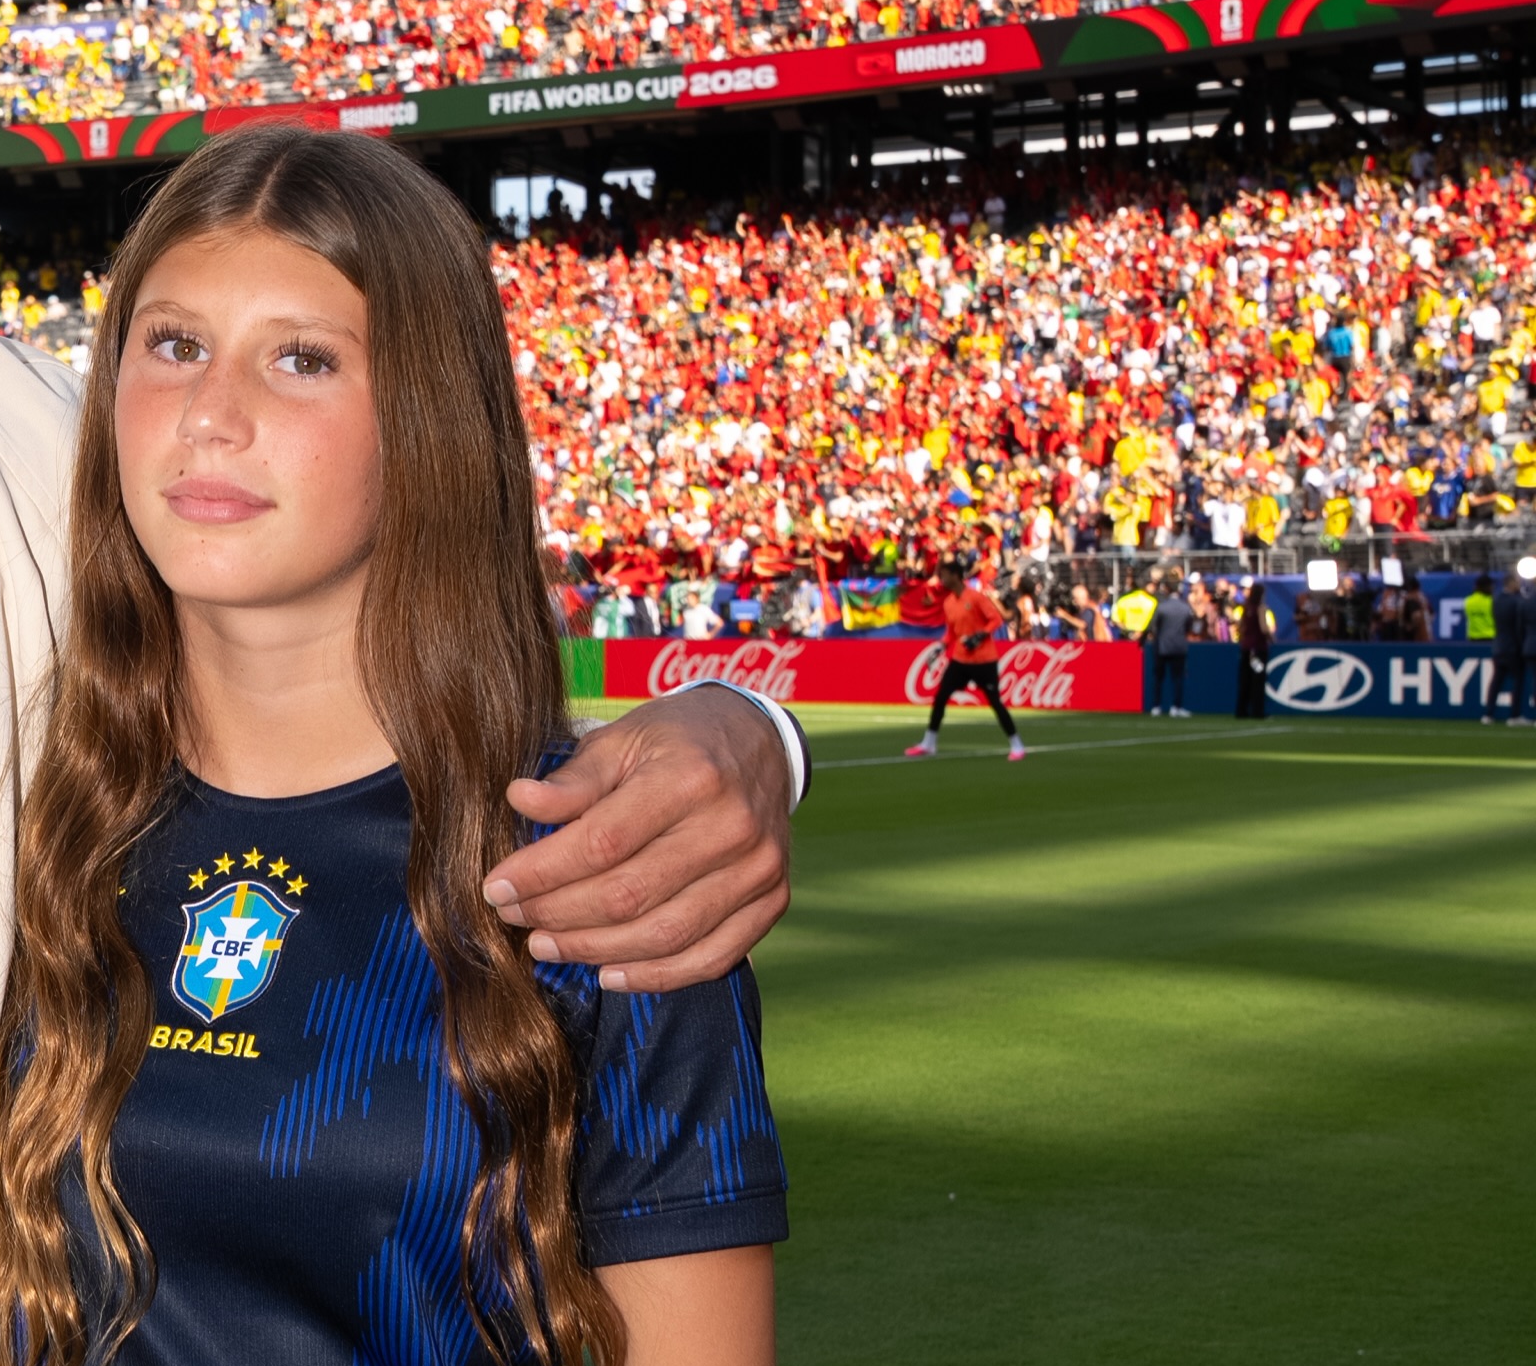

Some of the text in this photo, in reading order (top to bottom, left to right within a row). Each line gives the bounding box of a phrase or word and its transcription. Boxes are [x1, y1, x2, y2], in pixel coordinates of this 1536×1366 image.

[895, 37, 986, 74] MOROCCO
[488, 64, 779, 116] FIFA WORLD CUP 2026
[339, 100, 418, 129] MOROCCO
[211, 939, 253, 957] CBF
[149, 1025, 262, 1059] BRASIL
